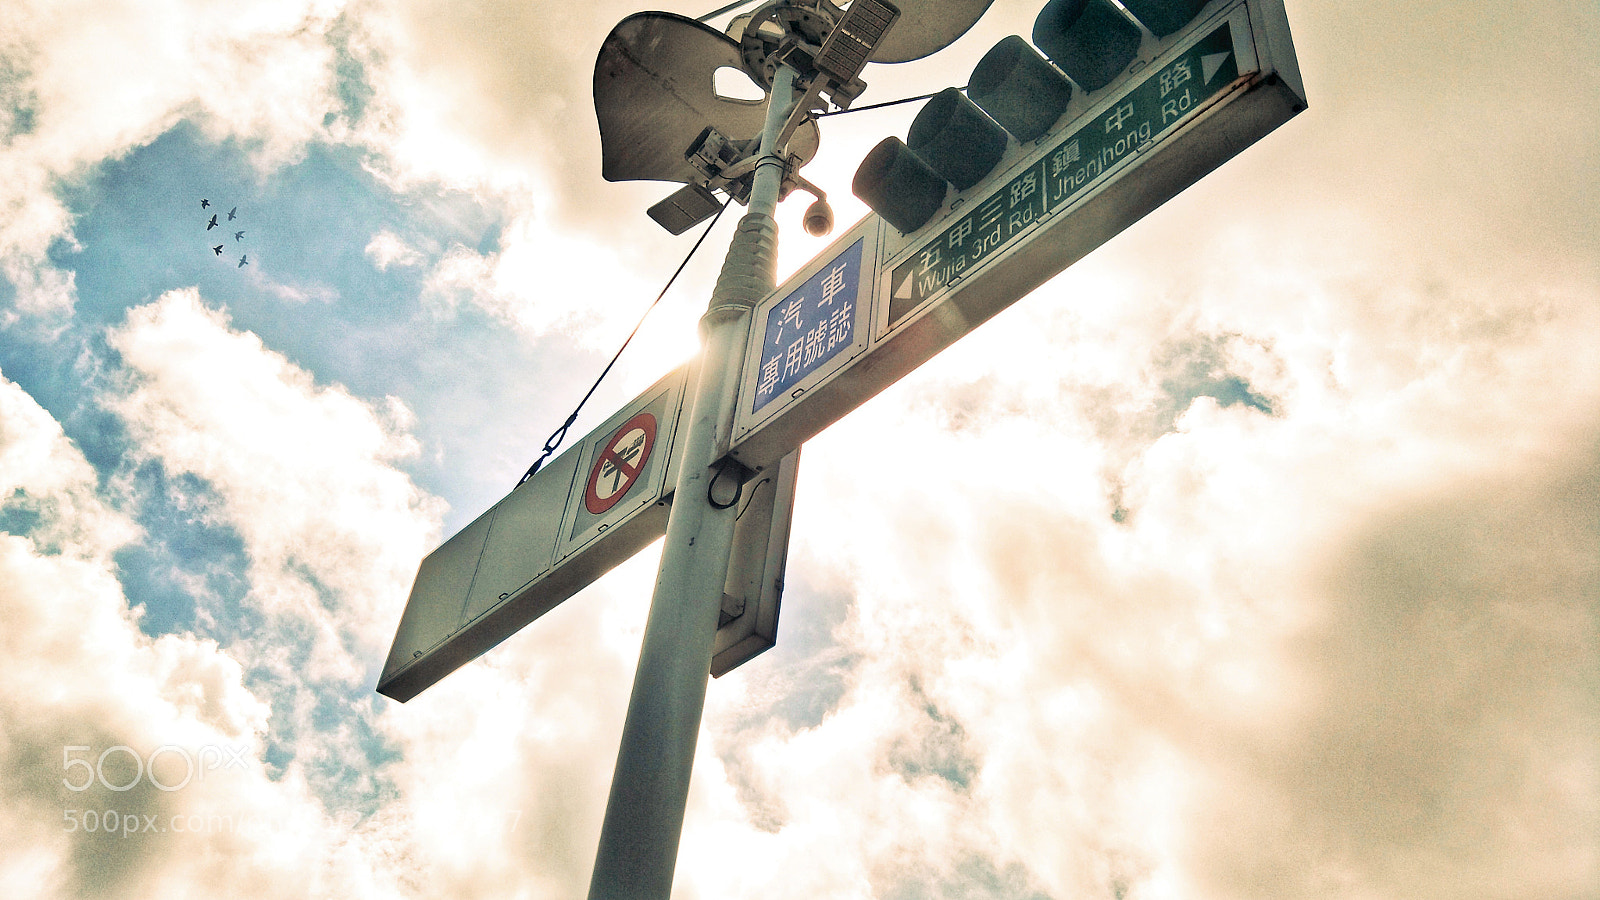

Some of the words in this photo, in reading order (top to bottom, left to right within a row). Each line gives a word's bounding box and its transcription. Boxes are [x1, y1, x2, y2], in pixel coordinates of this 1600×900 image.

[1053, 58, 1192, 178] 鎮中路
[1053, 121, 1151, 201] Jhenjhong
[1161, 88, 1198, 124] Rd.
[918, 171, 1037, 277] 五甲三路
[918, 254, 966, 298] Wujia
[972, 224, 1001, 260] 3rd
[1009, 202, 1038, 235] Rd.
[758, 301, 852, 395] 專用號誌
[774, 262, 847, 345] 汽車
